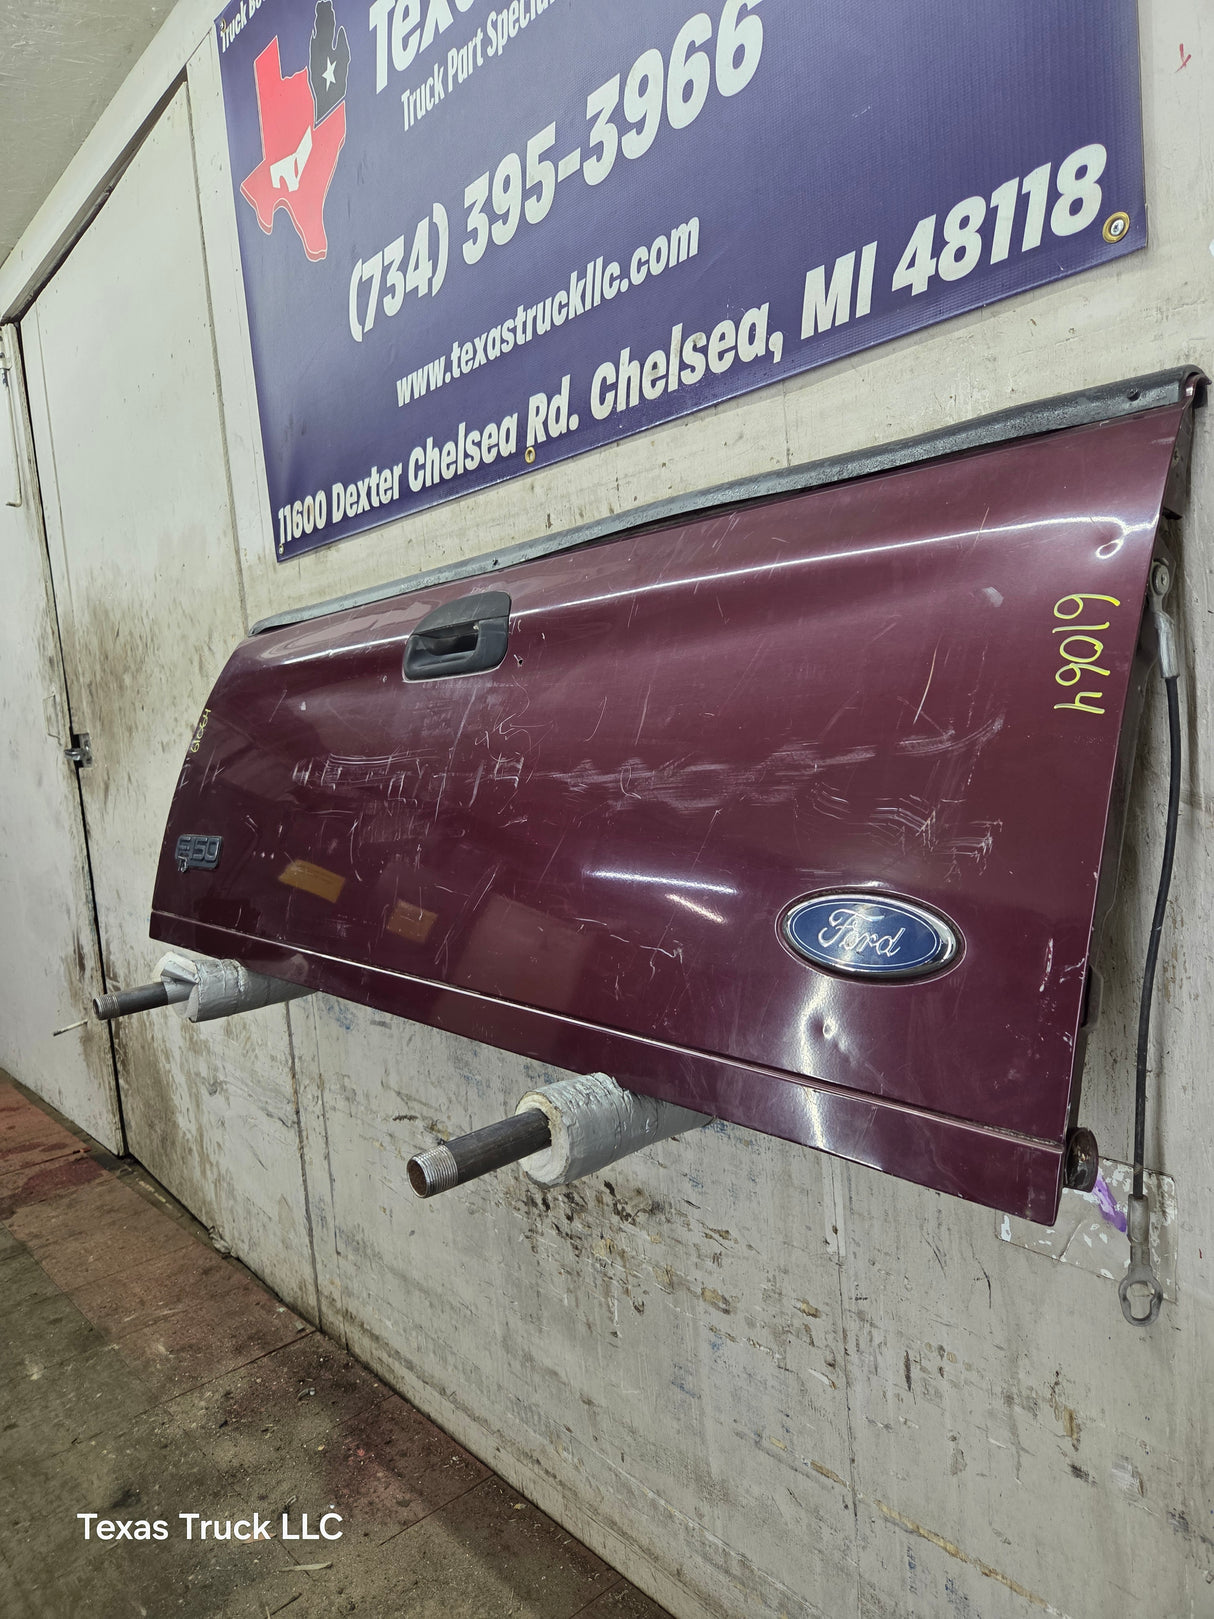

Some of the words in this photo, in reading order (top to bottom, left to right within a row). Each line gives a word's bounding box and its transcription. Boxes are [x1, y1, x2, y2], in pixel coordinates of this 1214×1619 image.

[220, 0, 247, 53] Truck
[369, 0, 476, 95] Tex
[401, 62, 446, 132] Truck
[447, 27, 484, 93] Part
[349, 202, 450, 343] (734)
[462, 0, 764, 266] 395-3966
[278, 490, 328, 545] 11600
[332, 462, 403, 524] Dexter
[408, 412, 518, 492] Chelsea
[526, 373, 580, 448] Rd.
[590, 302, 784, 421] Chelsea,
[801, 241, 878, 340] MI
[891, 142, 1108, 297] 48118
[396, 216, 700, 408] www.texastruckllc.com
[818, 908, 906, 957] Ford
